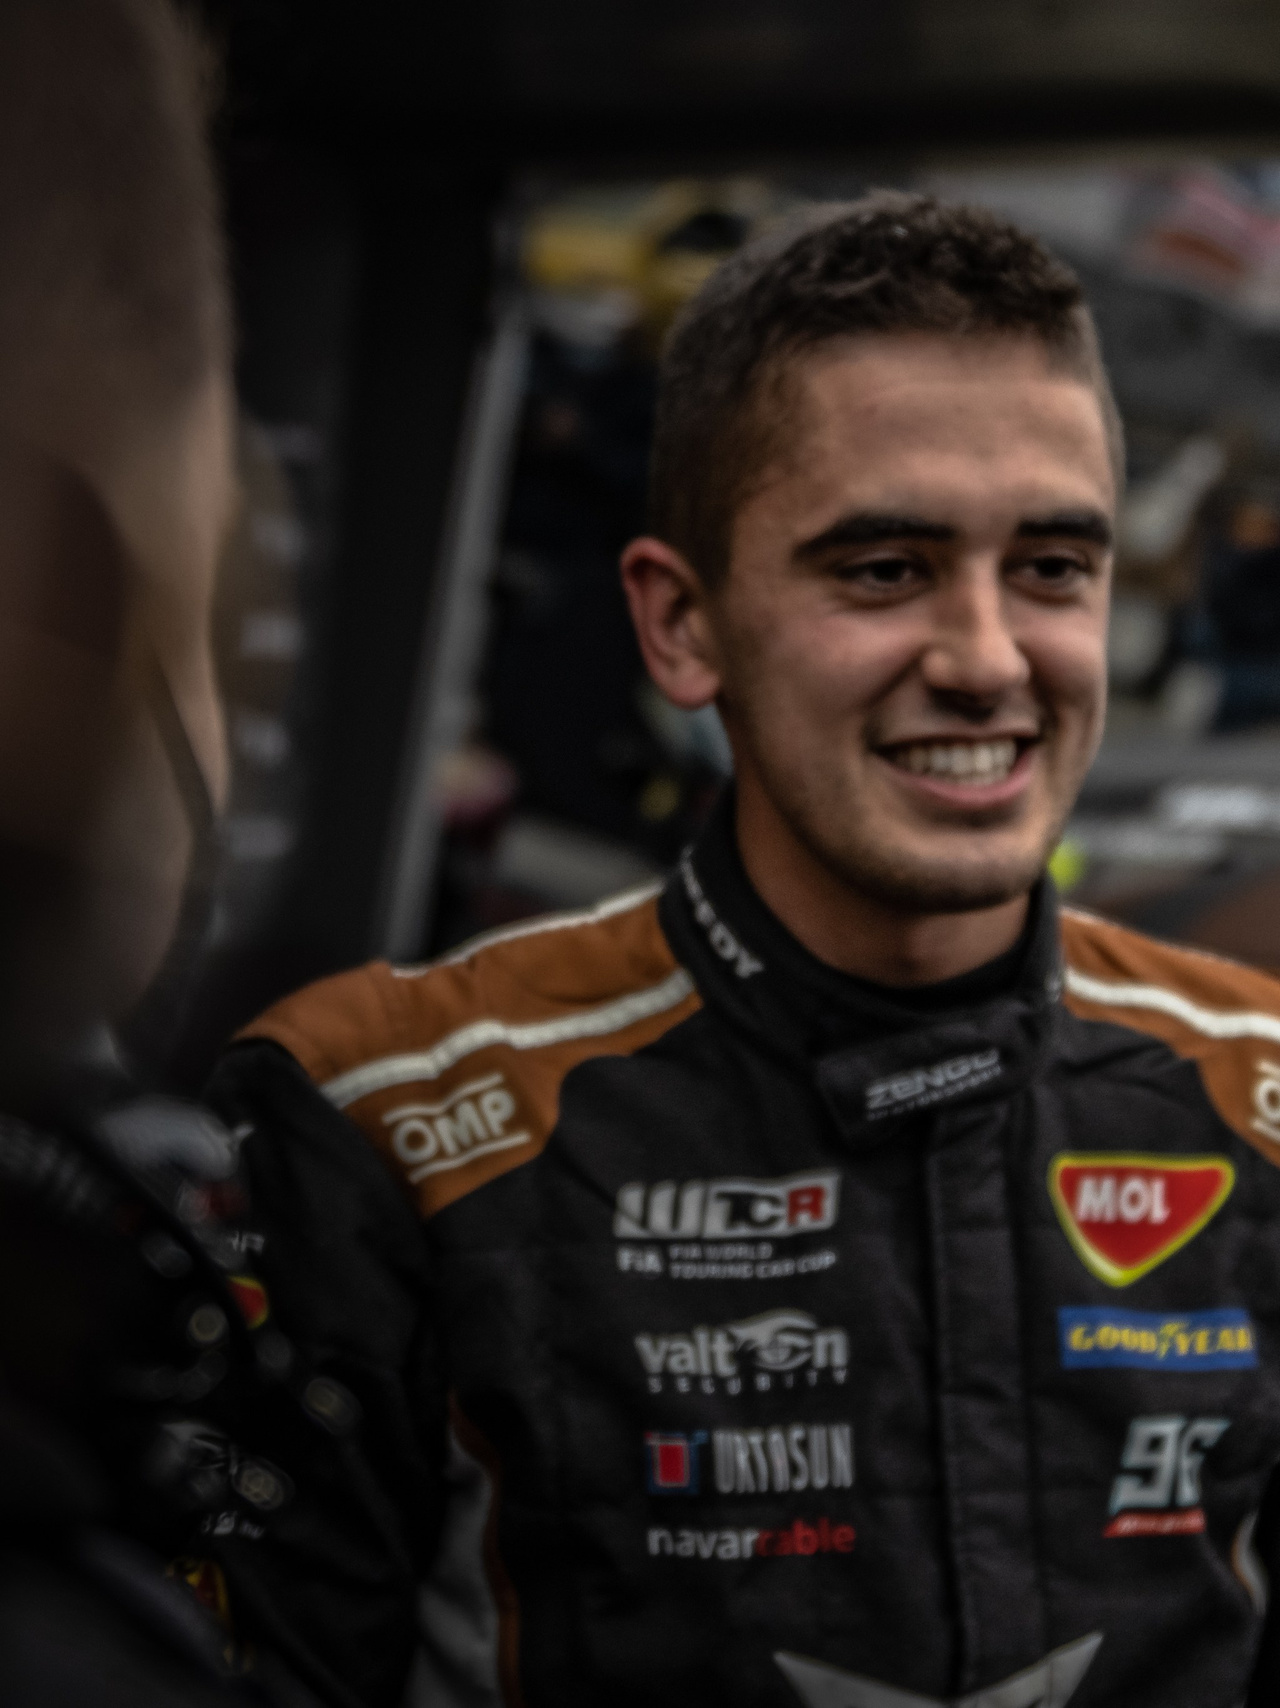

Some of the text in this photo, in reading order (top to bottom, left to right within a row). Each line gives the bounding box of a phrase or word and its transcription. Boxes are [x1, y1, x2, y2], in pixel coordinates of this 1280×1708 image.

[391, 1087, 516, 1165] OMP
[614, 1166, 842, 1240] WTCR
[1075, 1174, 1171, 1226] MOL
[616, 1244, 663, 1273] FIA
[646, 1516, 857, 1560] navarcable
